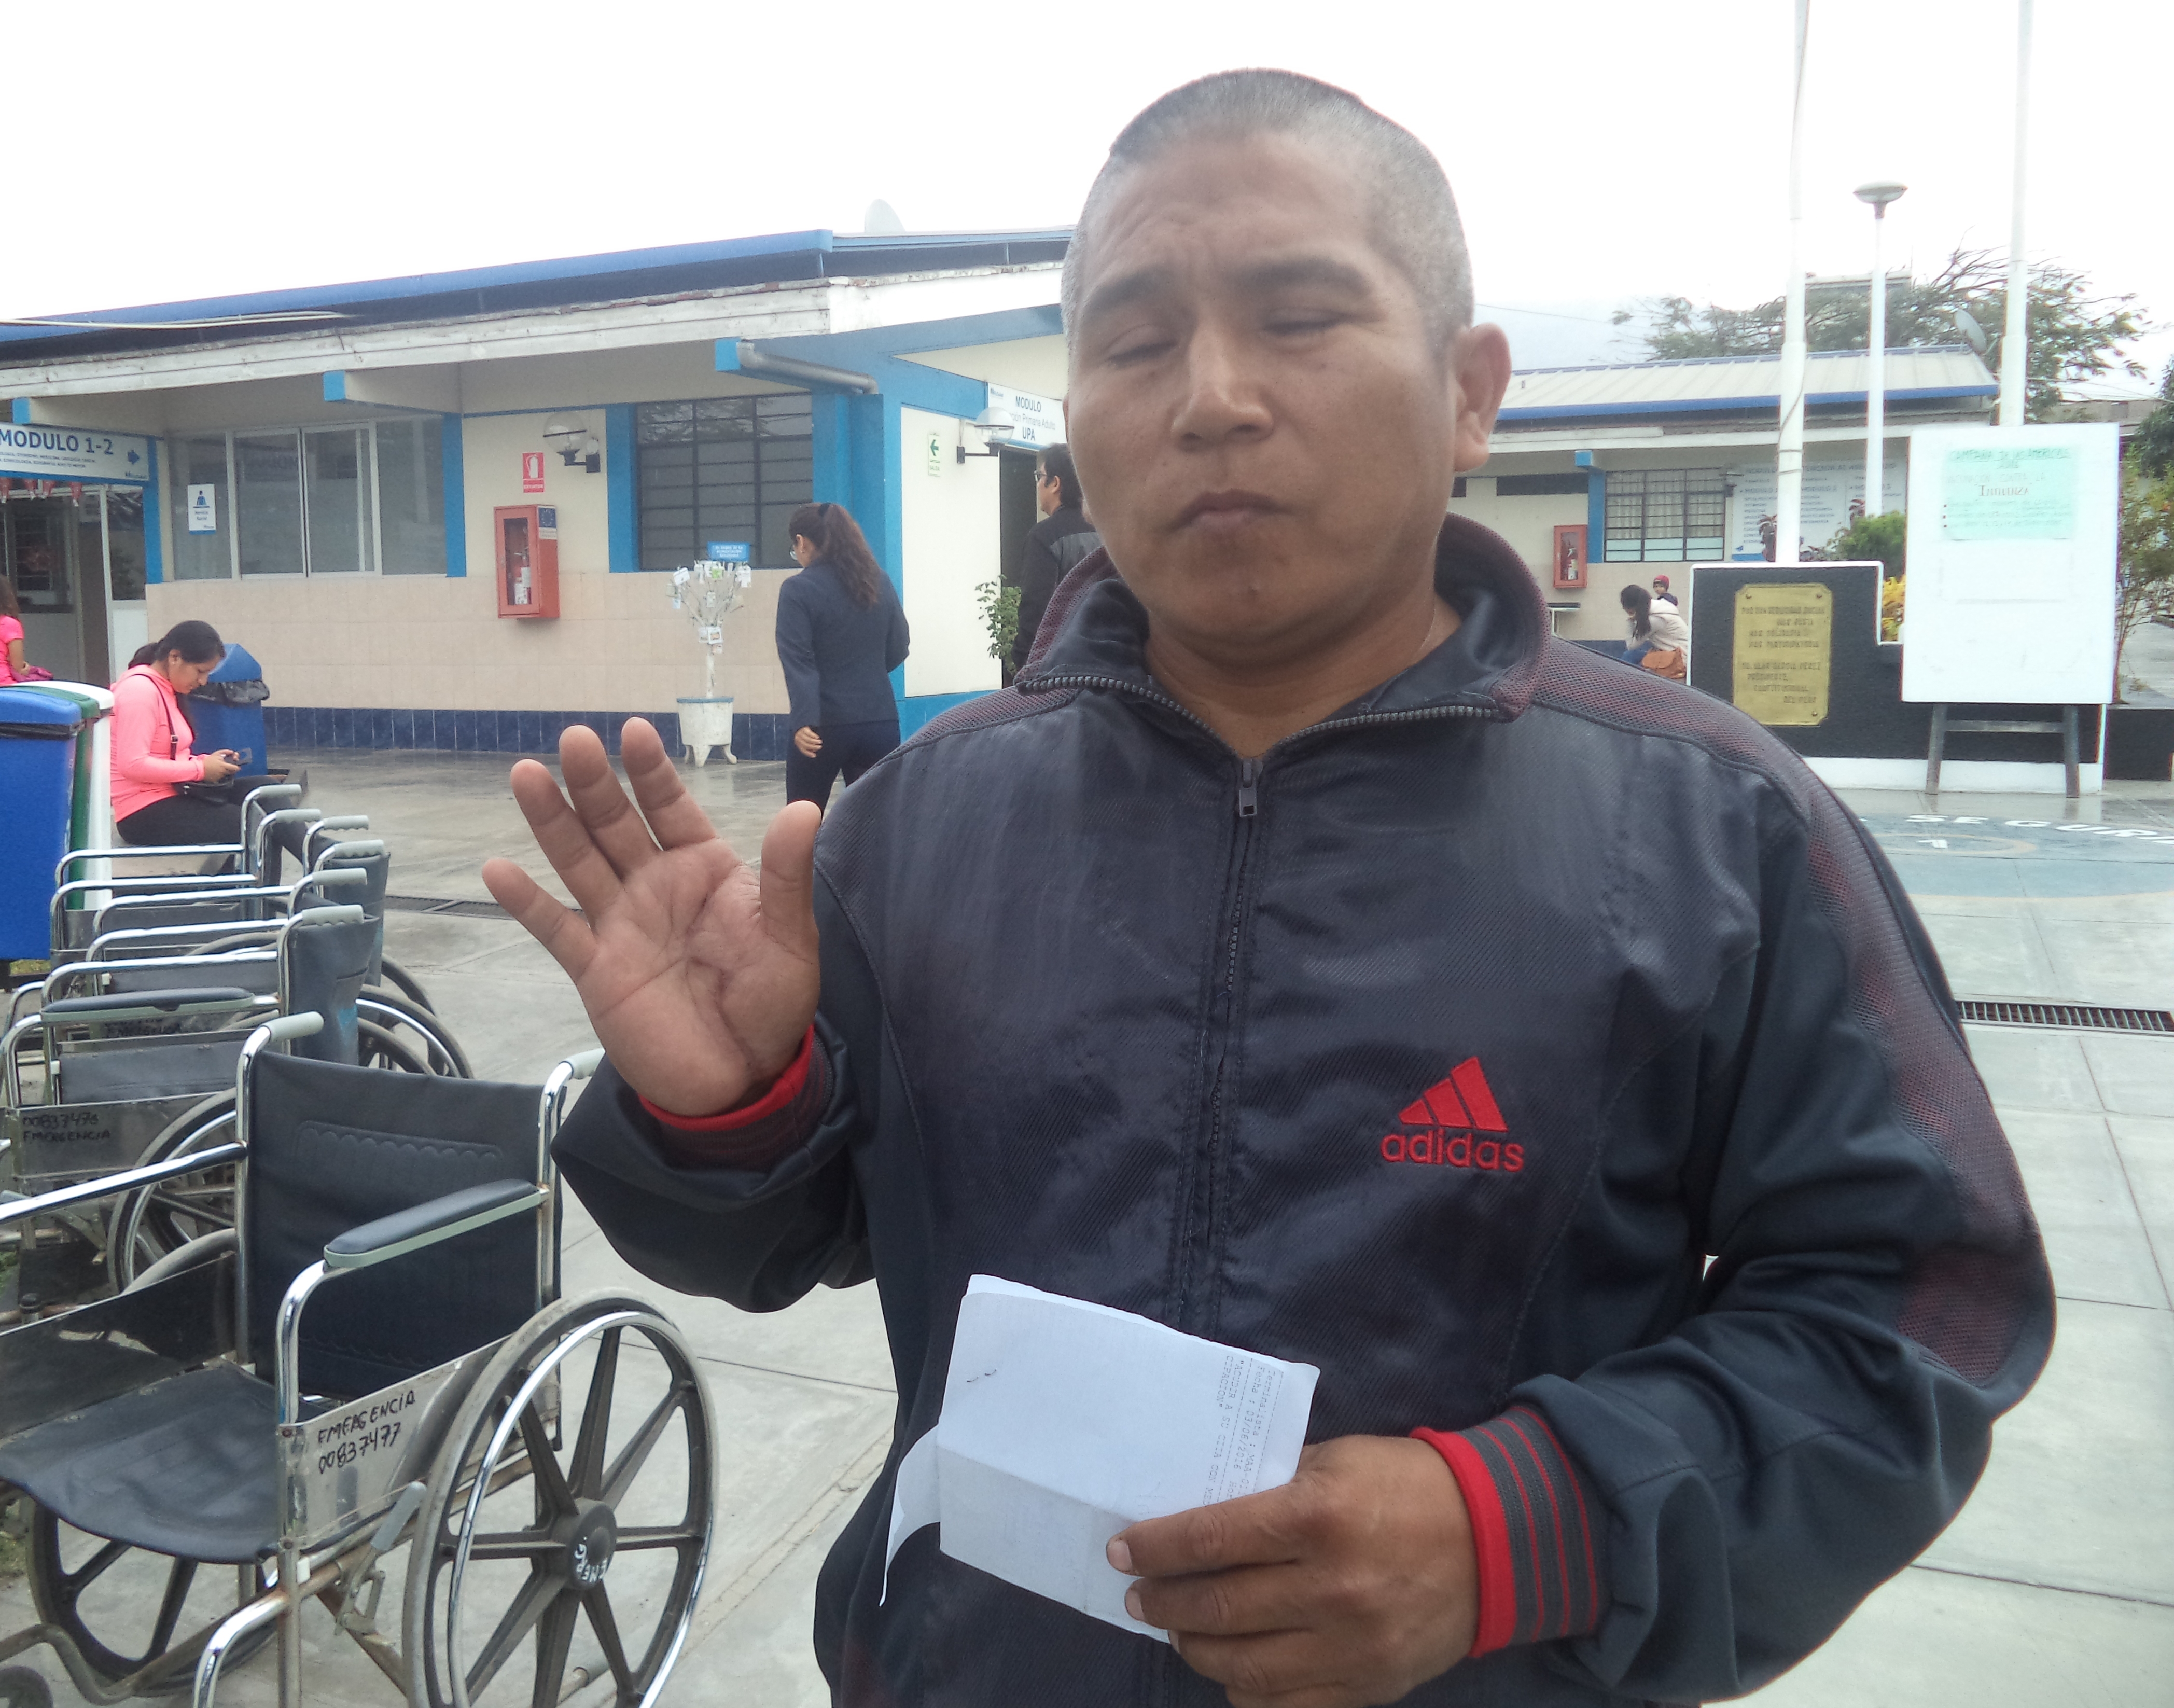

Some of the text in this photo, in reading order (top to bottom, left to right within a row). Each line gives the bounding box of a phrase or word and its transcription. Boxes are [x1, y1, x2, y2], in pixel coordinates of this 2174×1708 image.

[1015, 396, 1041, 412] MODULO
[85, 437, 114, 455] 1-2
[1022, 427, 1036, 441] UPA
[1379, 1128, 1525, 1173] adidas
[318, 1390, 415, 1444] EMERGENCIA
[318, 1422, 401, 1474] 00837477
